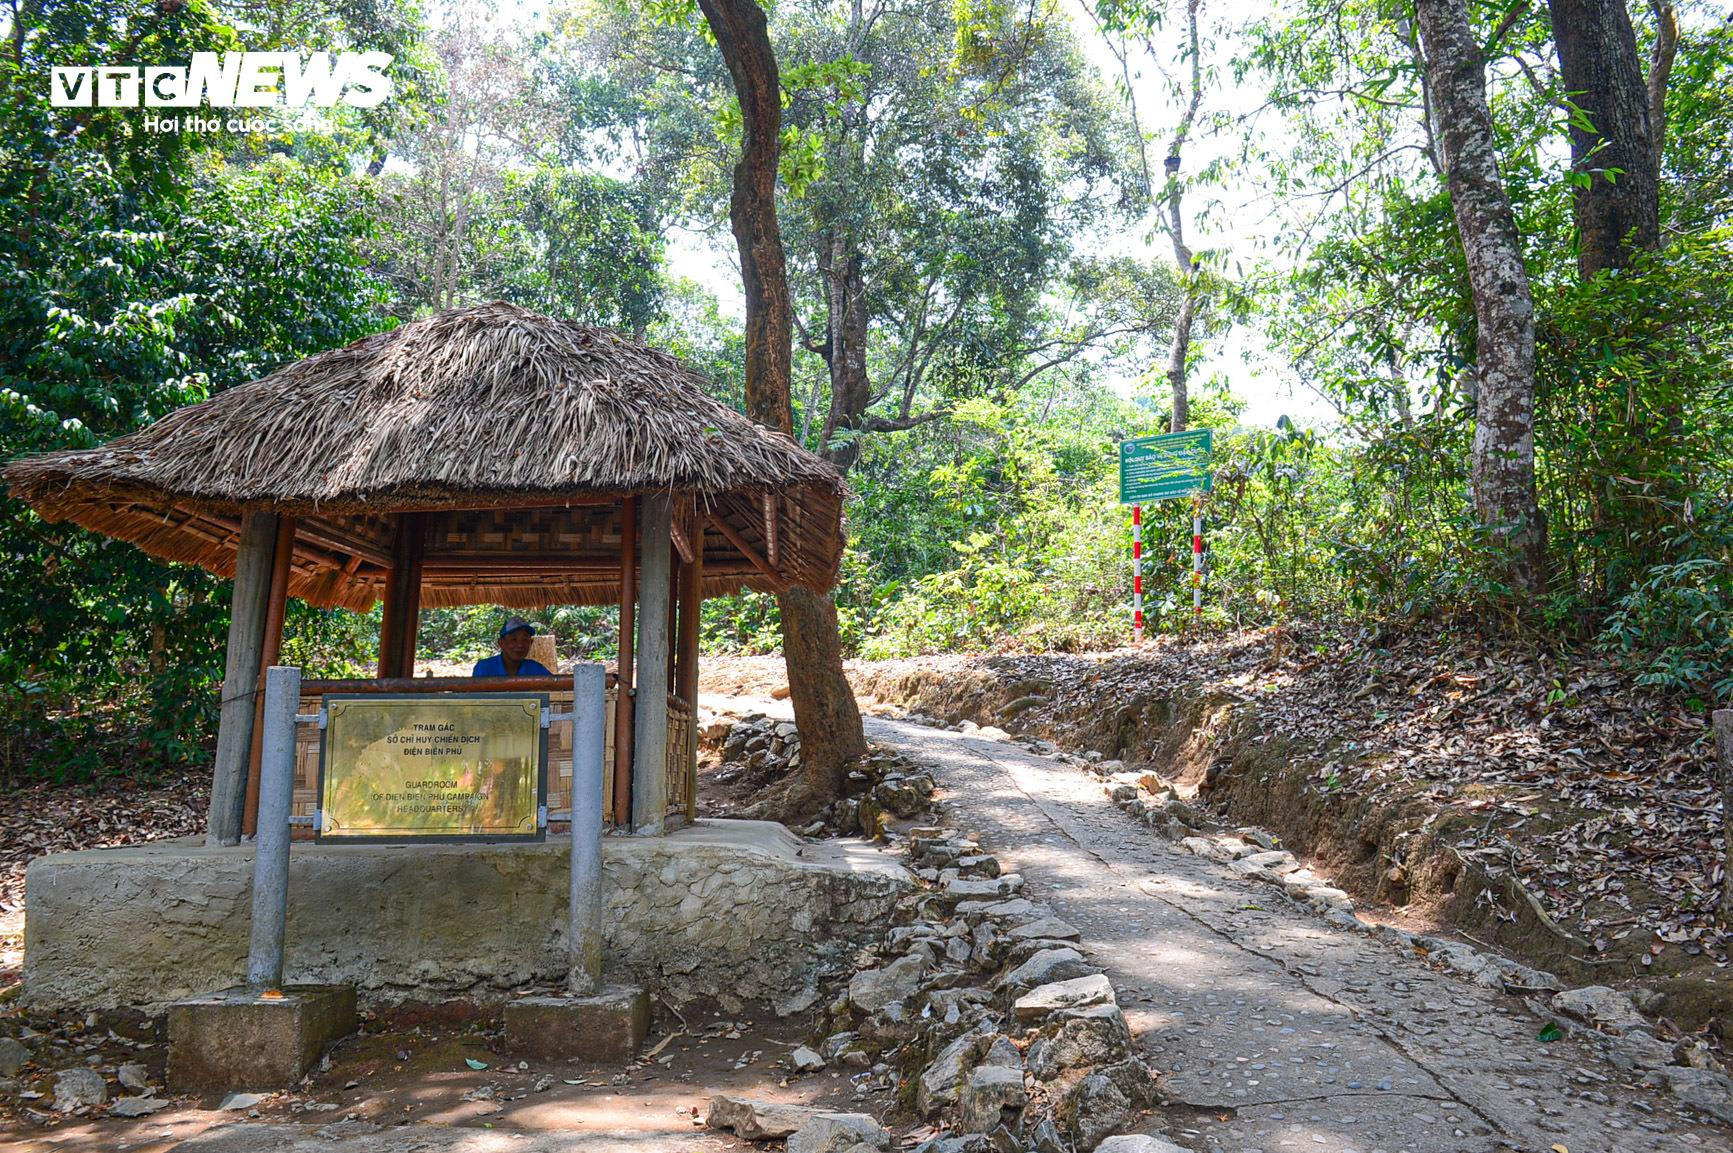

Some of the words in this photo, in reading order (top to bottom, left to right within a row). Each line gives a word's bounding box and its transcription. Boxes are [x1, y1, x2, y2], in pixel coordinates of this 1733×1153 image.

[437, 722, 455, 732] GÁC
[405, 780, 458, 789] GUARDROOM
[372, 793, 384, 801] OF
[428, 793, 445, 801] PHU
[446, 793, 489, 801] CAMPAIGN
[396, 805, 464, 813] HEADQUARTERS
